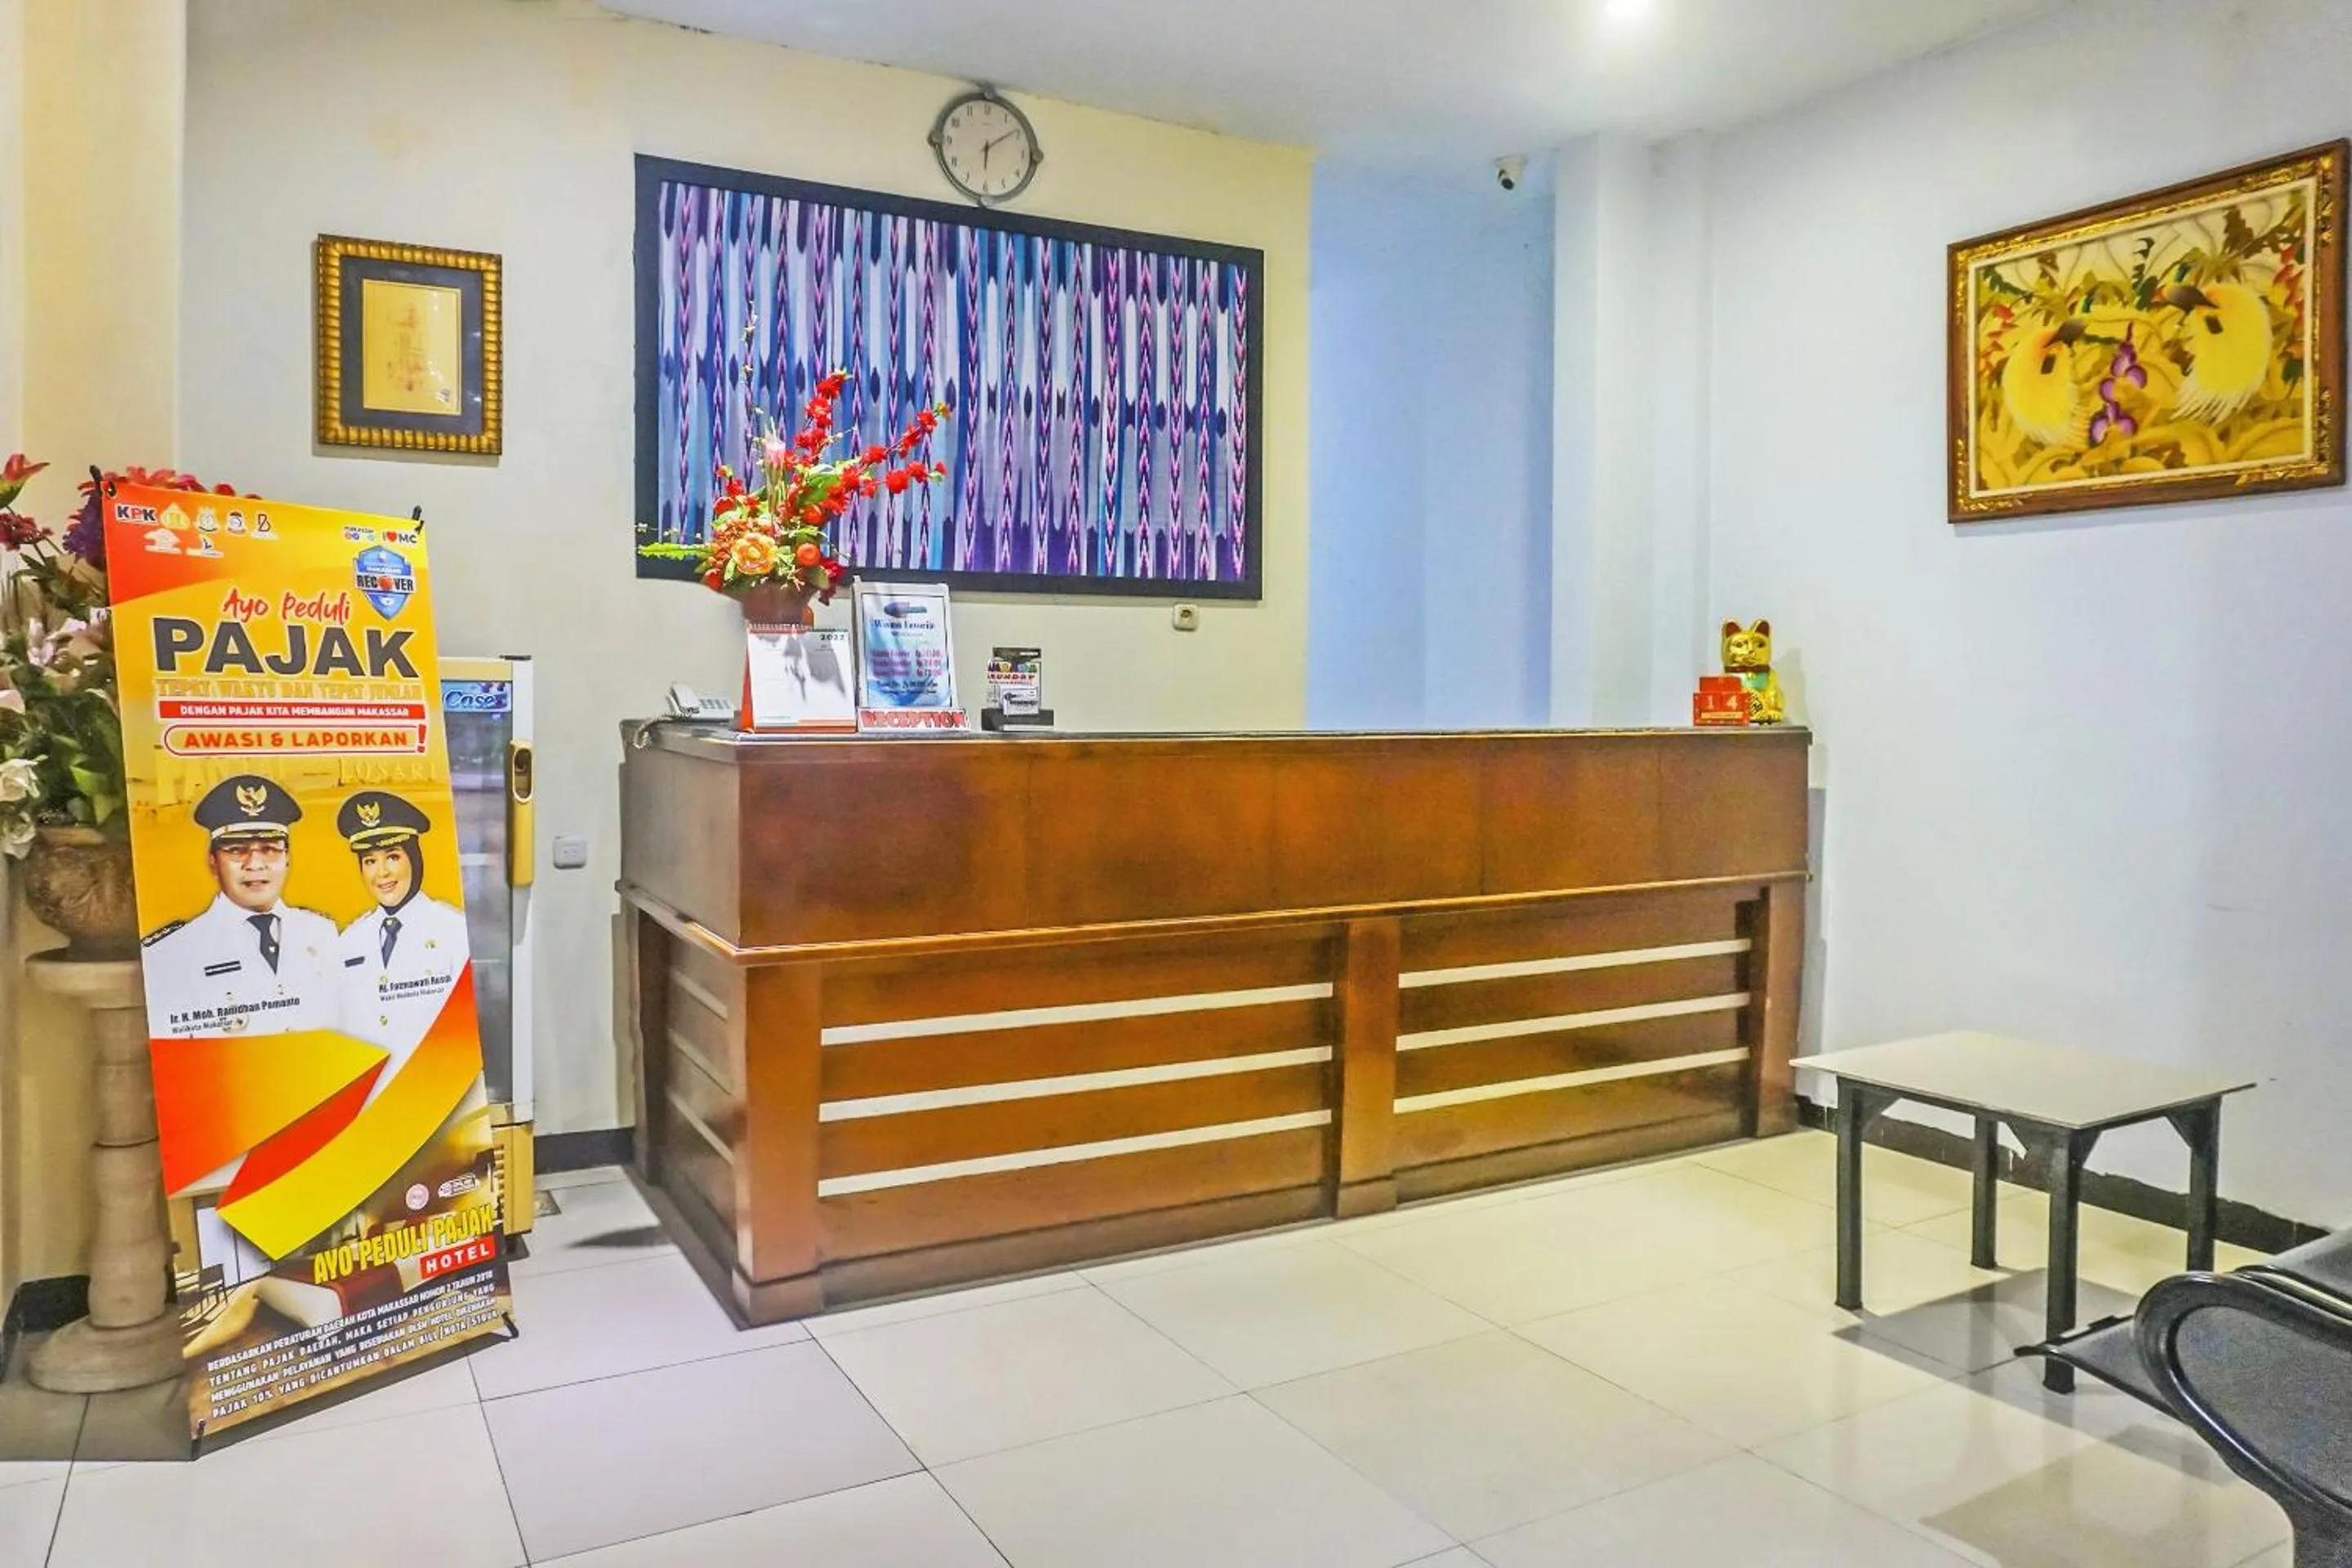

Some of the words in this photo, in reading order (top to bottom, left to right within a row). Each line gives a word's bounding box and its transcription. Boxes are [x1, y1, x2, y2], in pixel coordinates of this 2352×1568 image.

[117, 505, 156, 522] KPK
[399, 533, 417, 544] MC
[223, 588, 269, 623] Ayo
[281, 592, 350, 626] Peduli
[153, 617, 420, 678] PAJAK
[180, 705, 226, 715] DENGAN
[229, 706, 265, 715] PAJAK
[266, 706, 289, 715] KITA
[291, 706, 355, 716] MEMBANGUN
[861, 710, 967, 728] RECEPTION
[184, 733, 262, 747] AWASI
[270, 732, 283, 747] &
[292, 732, 408, 747] LAPORKAN
[313, 1245, 354, 1285] AYO
[359, 1223, 428, 1272] PEDULI
[431, 1203, 493, 1248] PAJAK
[425, 1242, 490, 1274] HOTEL
[273, 1325, 323, 1349] PERATURAN
[356, 1307, 376, 1323] KOTA
[377, 1293, 419, 1315] MAKASSAR
[209, 1363, 258, 1388] TENTANG
[262, 1351, 294, 1370] PAJAK
[345, 1324, 372, 1340] MAKA
[376, 1312, 408, 1330] SETIAP
[212, 1397, 247, 1419] PAJAK
[252, 1390, 274, 1404] 10%
[278, 1378, 305, 1395] YANG
[310, 1352, 381, 1384] DICANTUMKAN
[383, 1339, 416, 1356] DALAM
